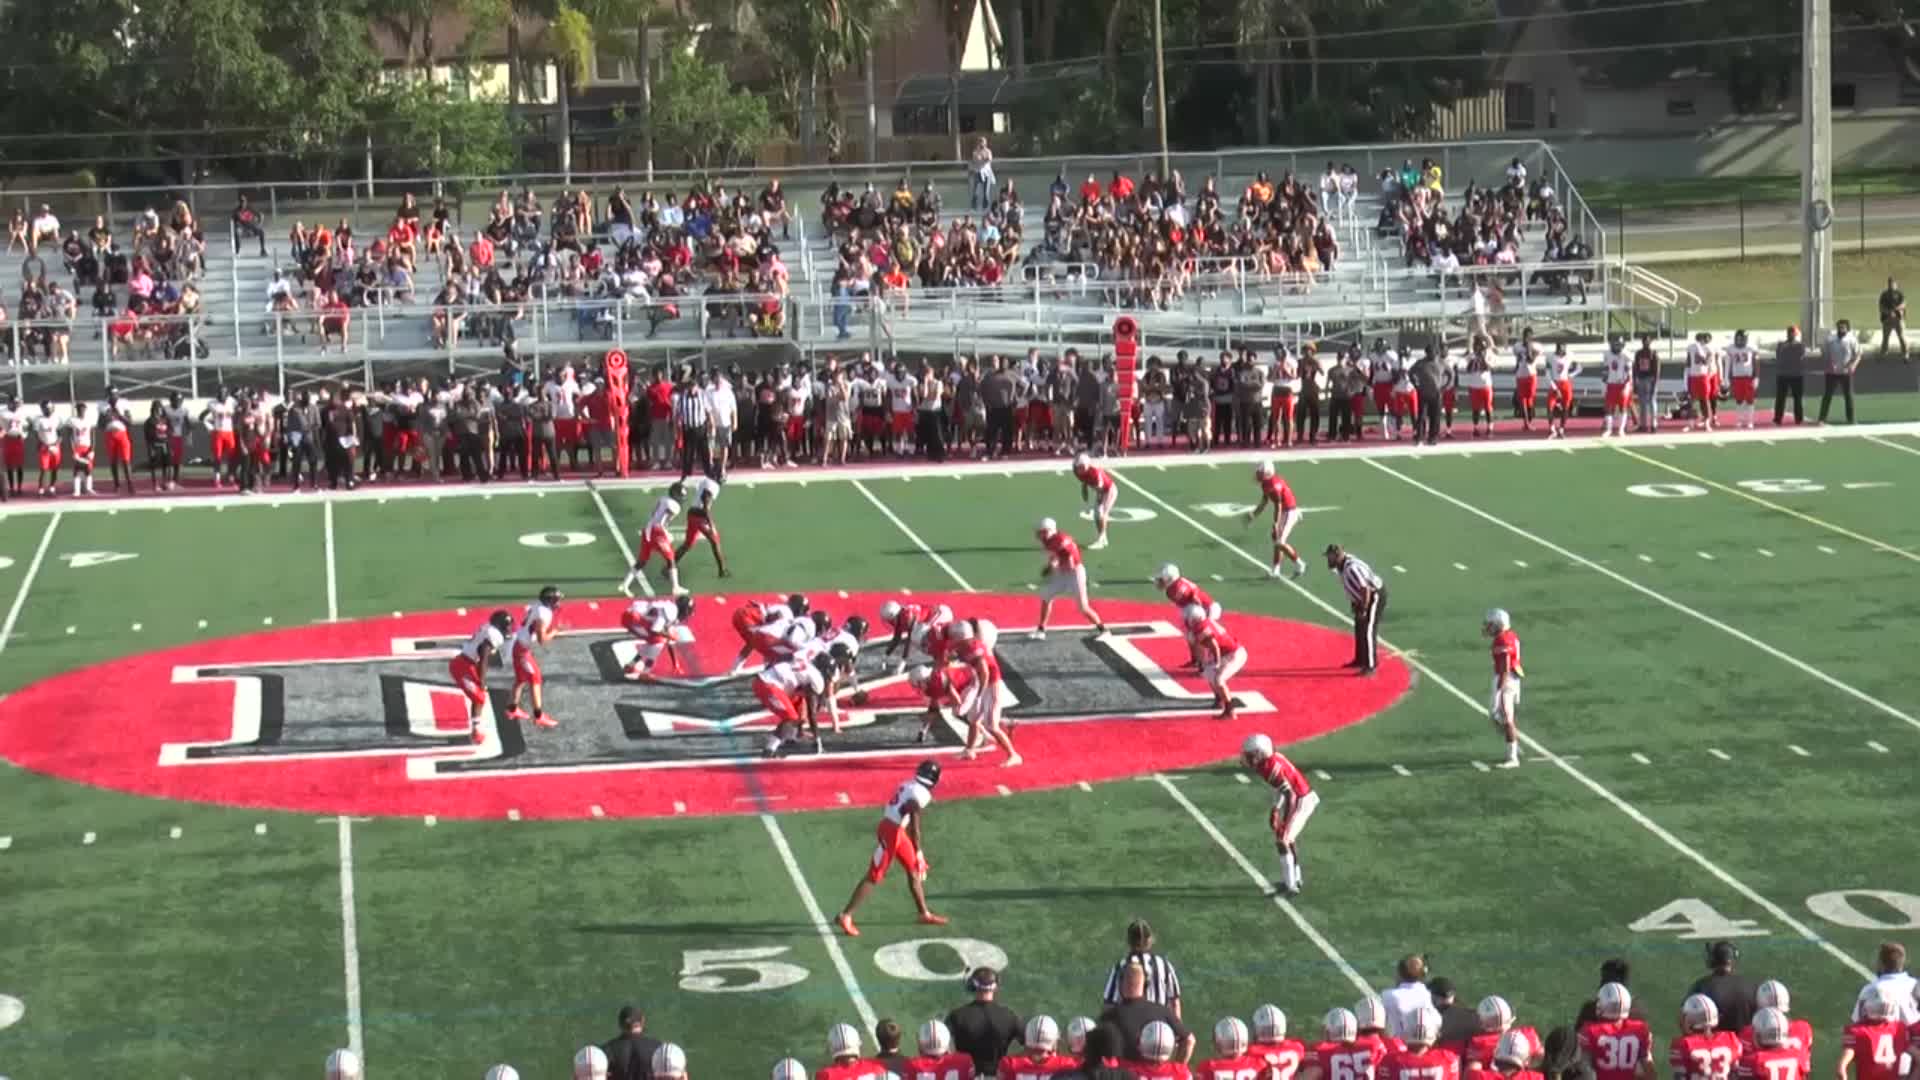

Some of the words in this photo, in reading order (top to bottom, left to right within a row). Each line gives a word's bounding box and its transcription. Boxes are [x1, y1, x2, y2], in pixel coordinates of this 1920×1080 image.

[1627, 889, 1920, 938] 40
[678, 937, 1009, 992] 50
[1597, 1035, 1641, 1070] 30
[1873, 1033, 1897, 1068] 4
